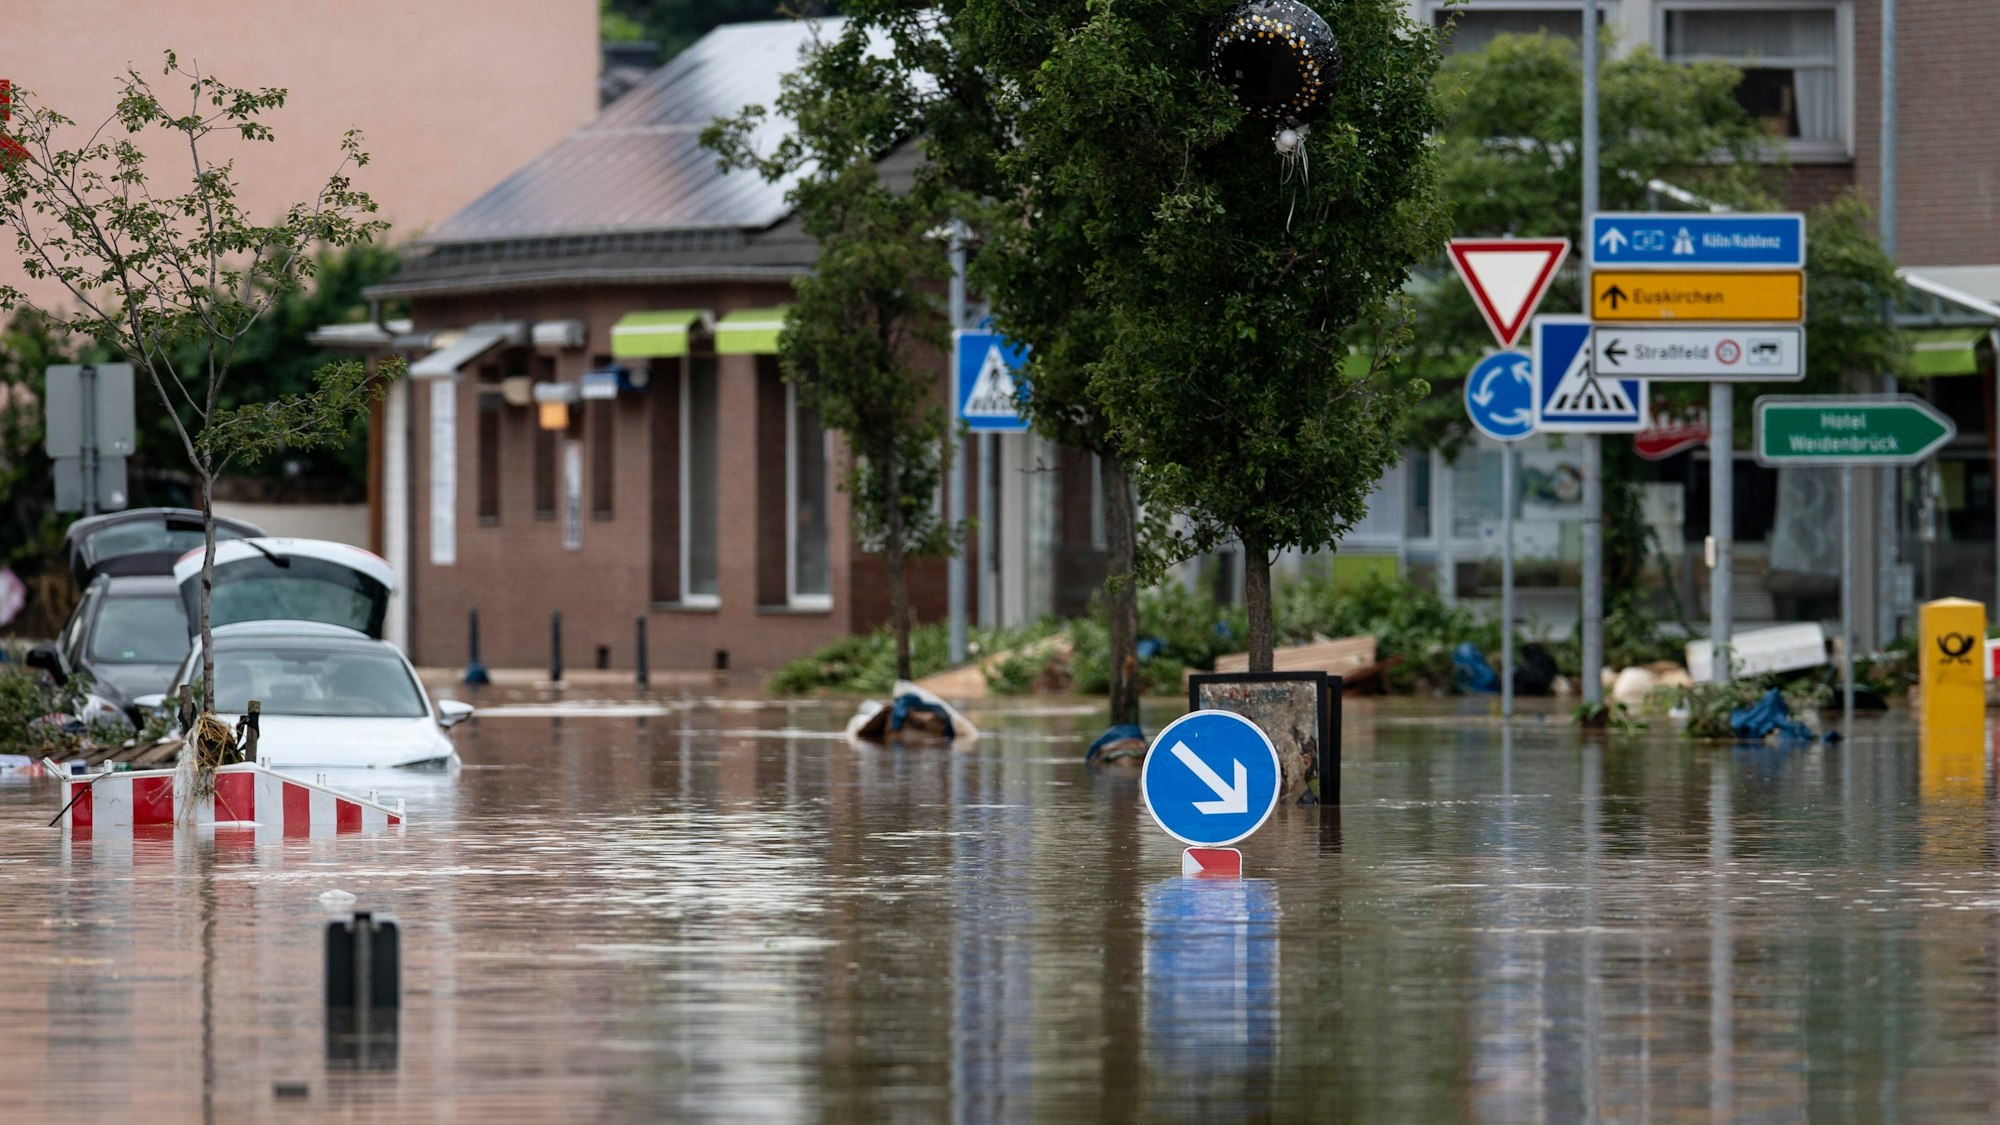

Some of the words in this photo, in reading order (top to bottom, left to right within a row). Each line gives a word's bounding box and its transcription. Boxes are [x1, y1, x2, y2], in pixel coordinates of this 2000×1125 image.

[1632, 288, 1725, 304] Euskirchen
[1634, 344, 1710, 361] Straßfeld
[1820, 413, 1866, 428] Hotel
[1788, 434, 1898, 451] Weidenbrück
